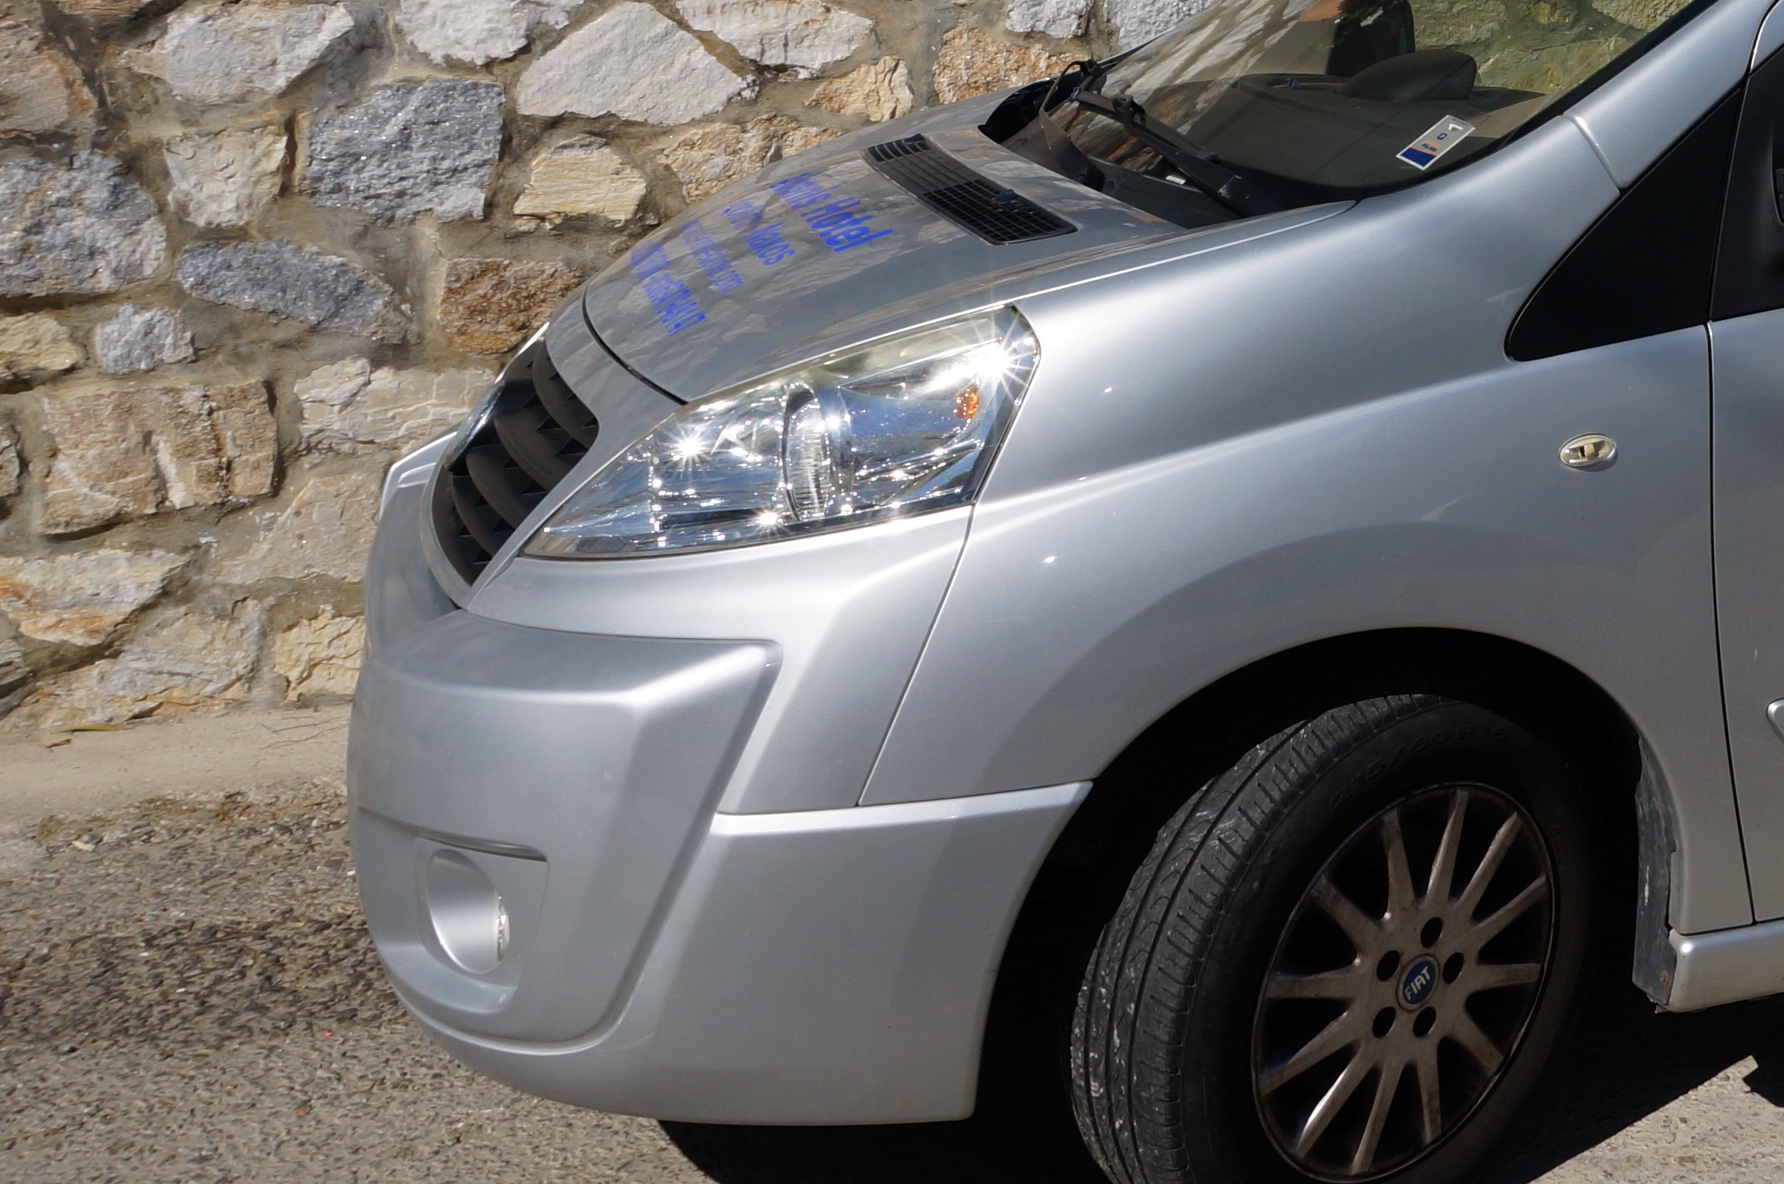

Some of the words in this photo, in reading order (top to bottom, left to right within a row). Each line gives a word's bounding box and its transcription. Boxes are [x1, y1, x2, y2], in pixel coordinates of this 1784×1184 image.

[742, 221, 796, 266] Naxos
[800, 196, 894, 253] Hotel
[1404, 965, 1431, 1001] FIAT
